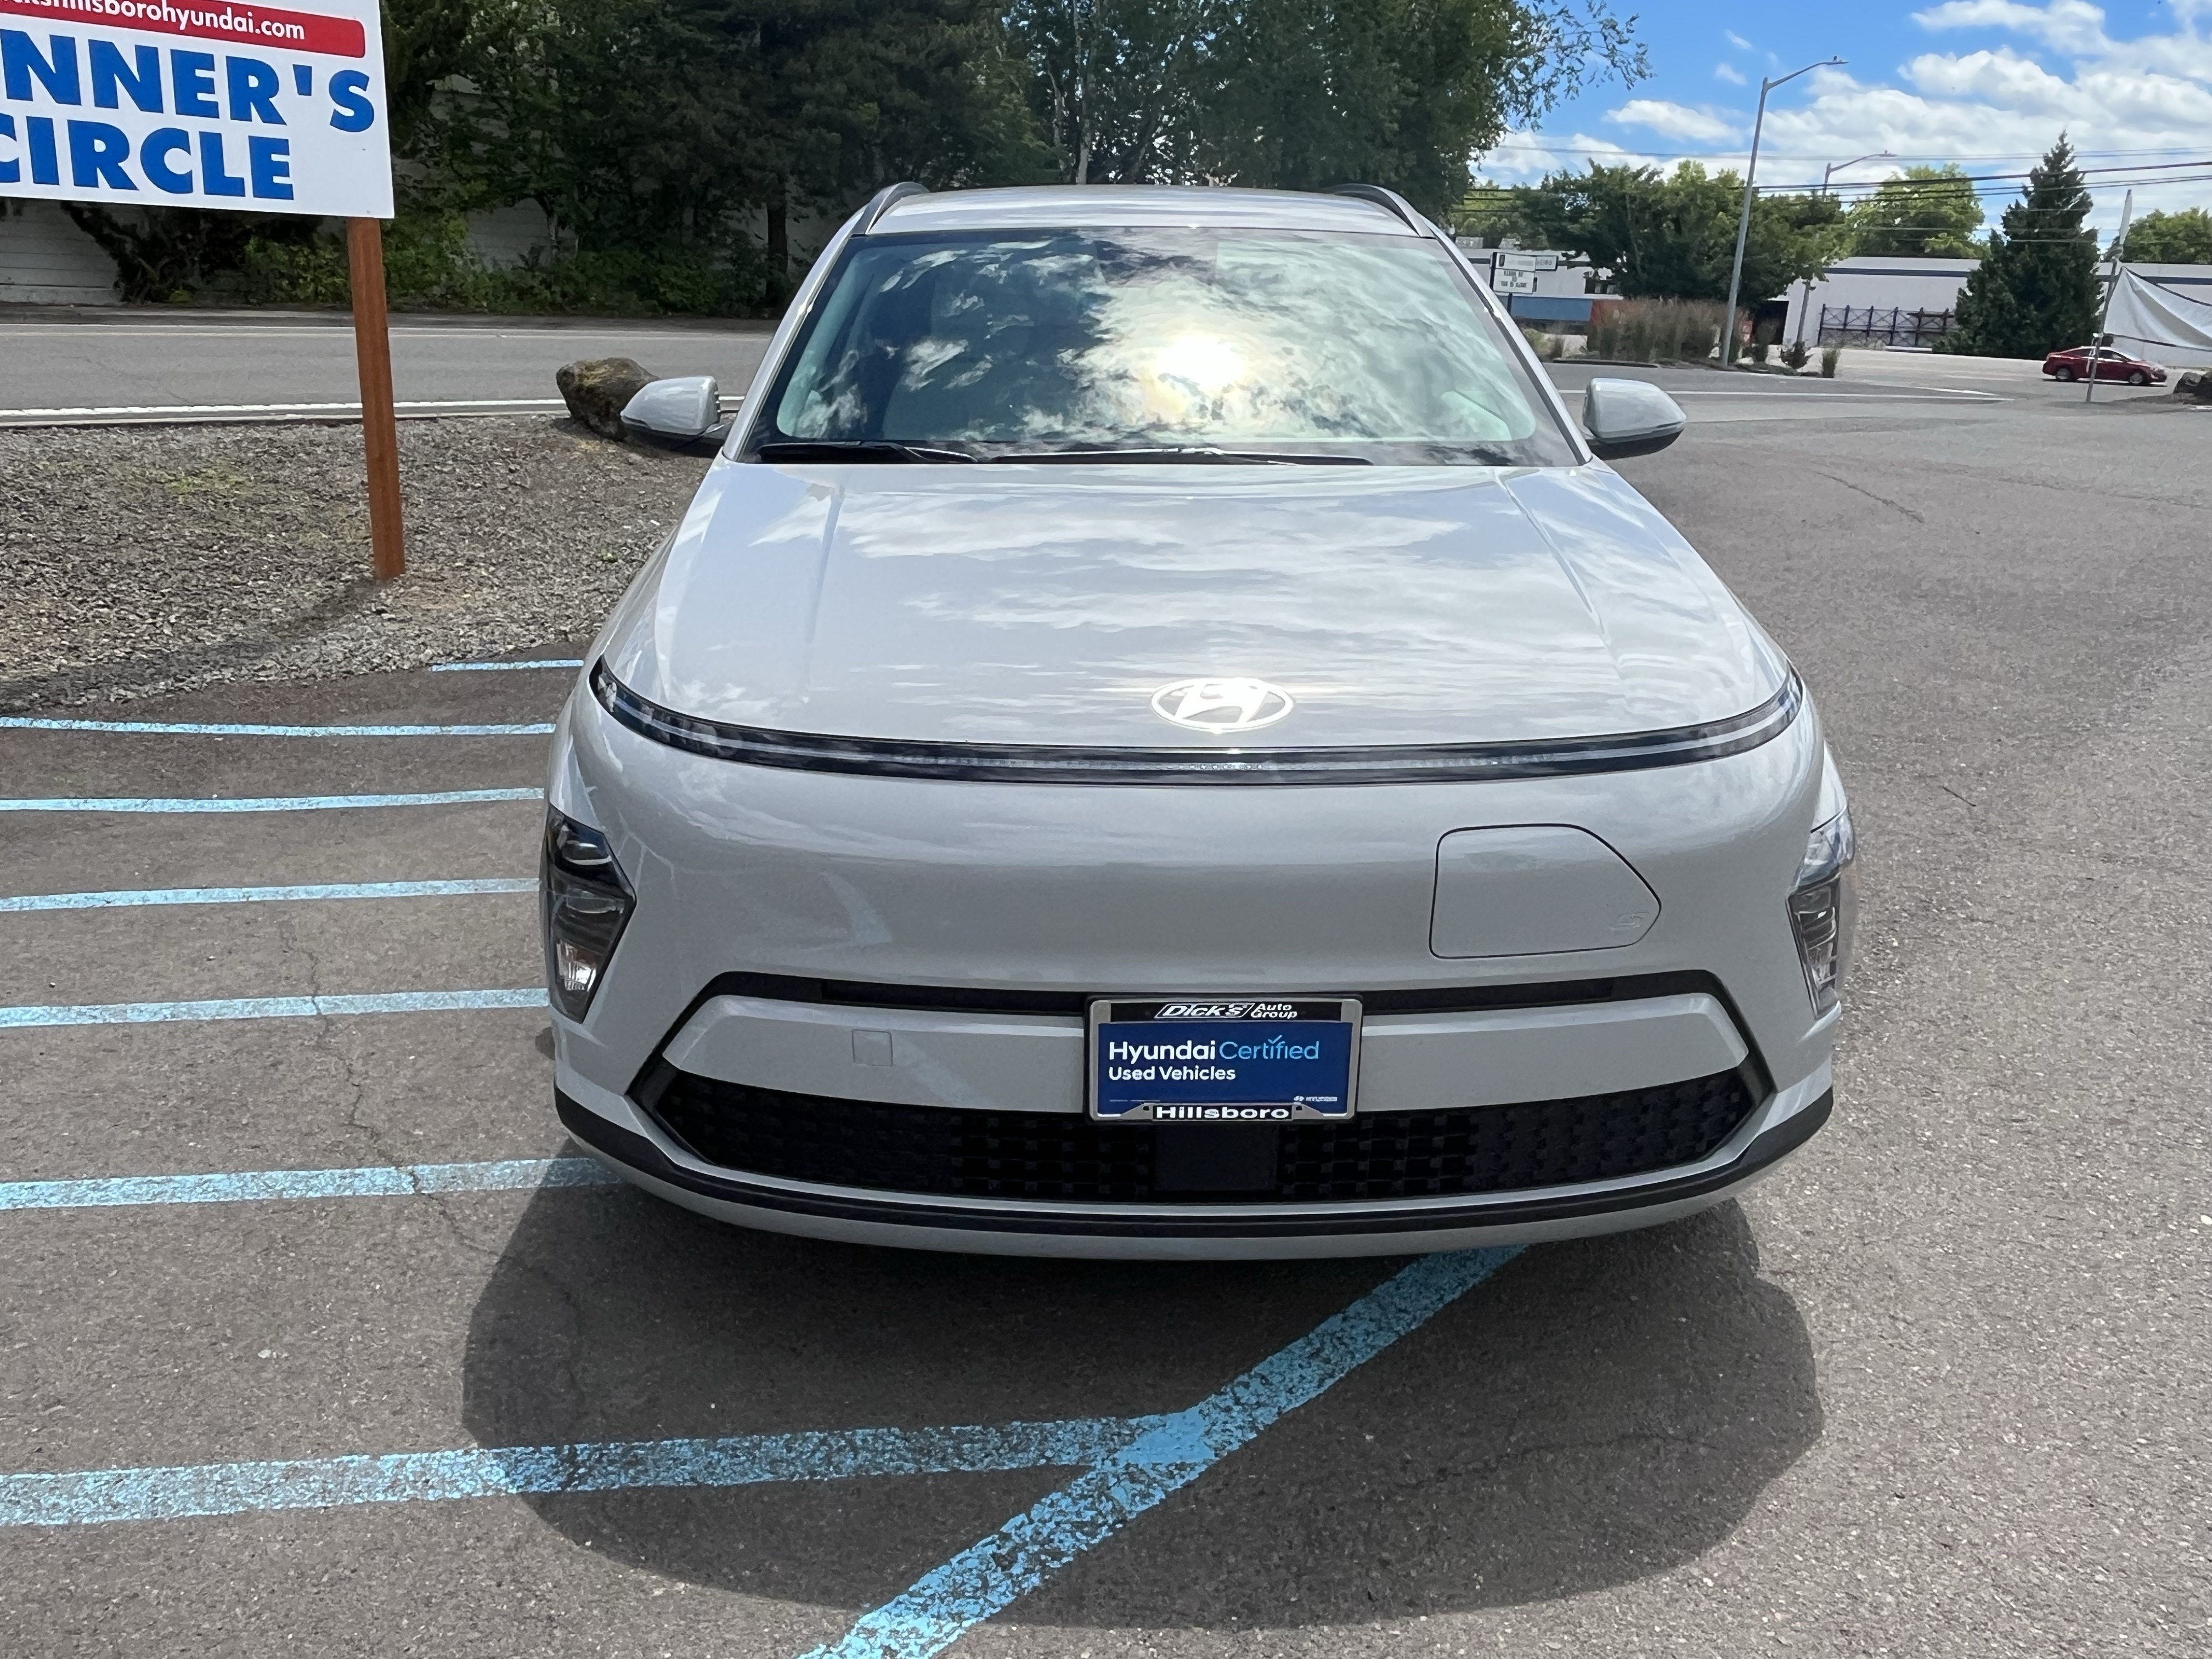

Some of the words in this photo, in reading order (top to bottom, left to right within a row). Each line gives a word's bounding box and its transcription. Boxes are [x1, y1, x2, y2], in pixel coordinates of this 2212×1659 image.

[4, 0, 305, 40] sborohyundai.com
[0, 29, 375, 133] NNER'S
[1250, 1011, 1297, 1019] Group
[1109, 1040, 1216, 1064] Hyundai
[1219, 1035, 1319, 1059] Certified
[1109, 1066, 1155, 1080] Used
[1159, 1065, 1236, 1080] Vehicles
[1156, 1106, 1290, 1119] Hillsboro
